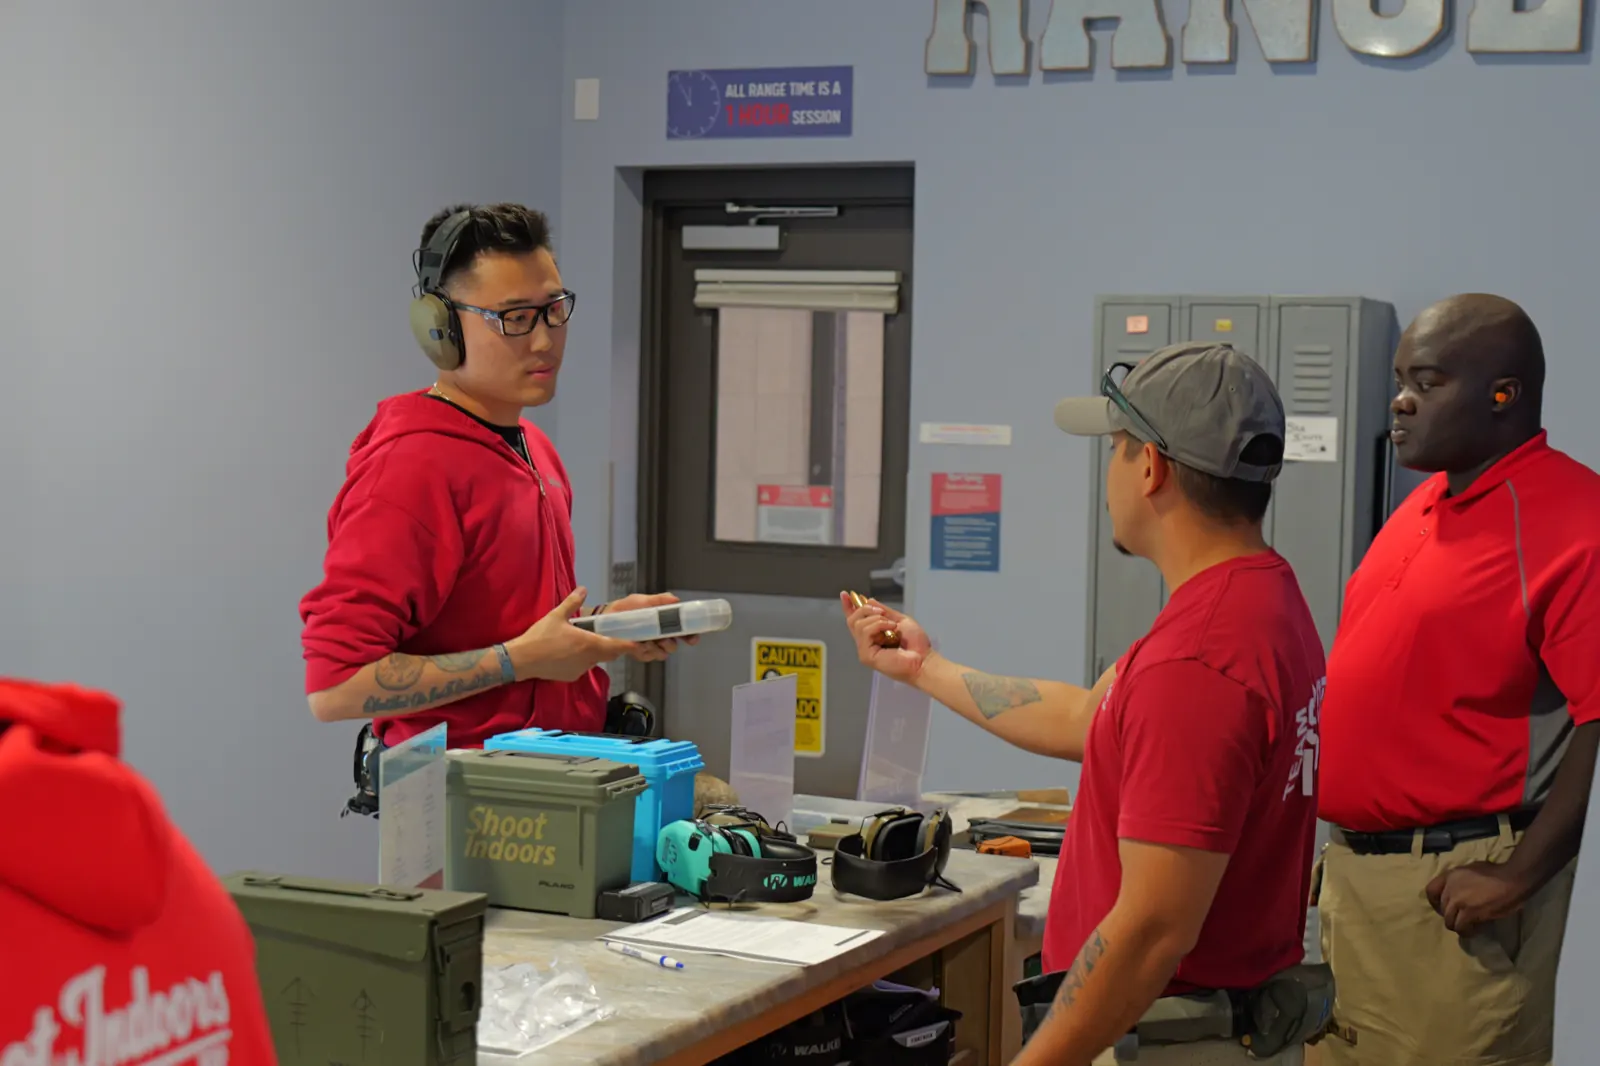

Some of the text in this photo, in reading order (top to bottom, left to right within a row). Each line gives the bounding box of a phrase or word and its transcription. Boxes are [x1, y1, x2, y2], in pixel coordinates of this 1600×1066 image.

[725, 80, 841, 98] ALL RANGE TIME IS A
[725, 103, 841, 126] 1 HOUR SESSION
[758, 645, 821, 669] CAUTION
[469, 805, 548, 841] Shoot
[464, 829, 557, 866] Indoors
